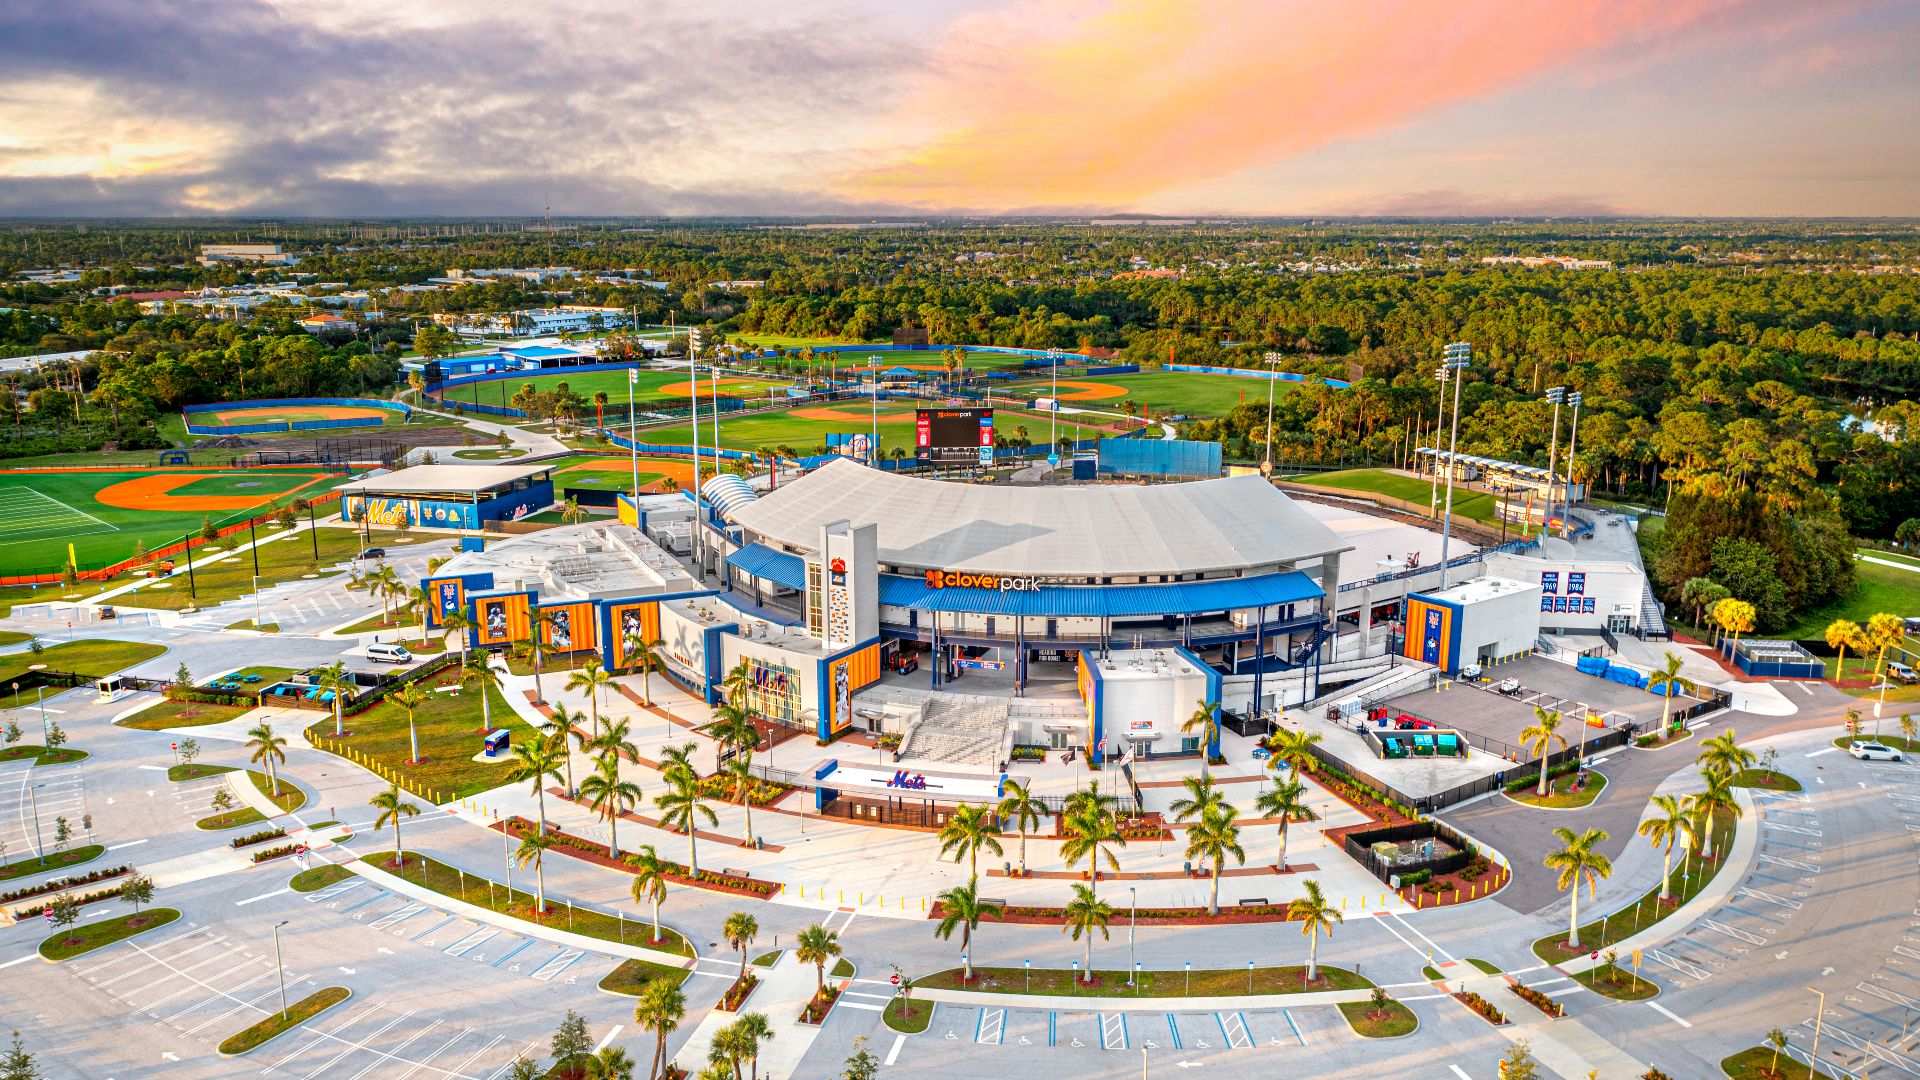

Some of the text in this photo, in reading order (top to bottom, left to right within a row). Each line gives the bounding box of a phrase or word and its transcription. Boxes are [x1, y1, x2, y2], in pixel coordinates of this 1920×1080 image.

[945, 570, 1040, 593] clover park
[1542, 582, 1557, 590] 1969
[1568, 583, 1583, 591] 1986
[748, 665, 788, 698] Mets
[886, 769, 926, 790] Mets
